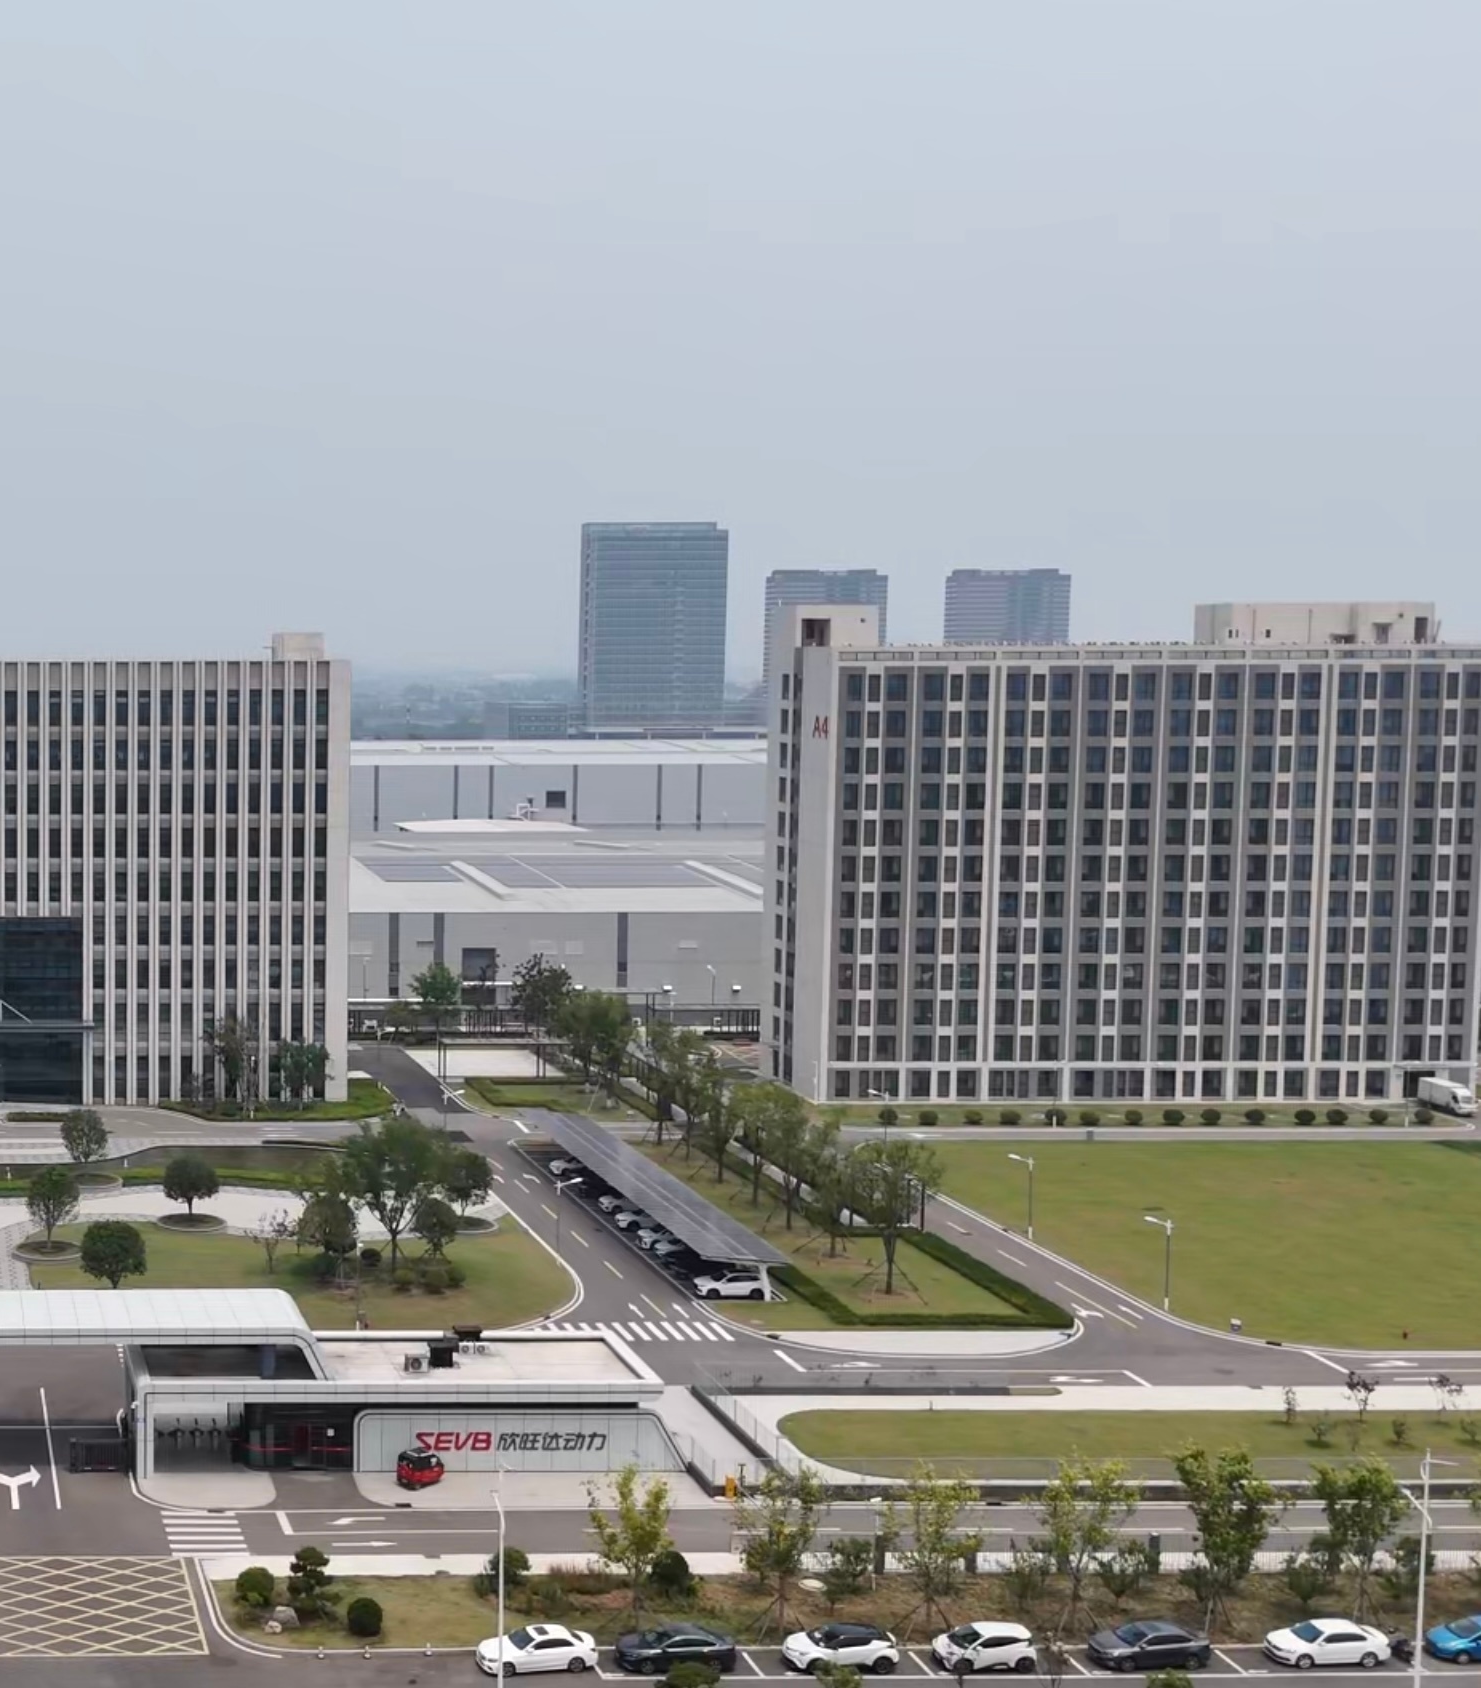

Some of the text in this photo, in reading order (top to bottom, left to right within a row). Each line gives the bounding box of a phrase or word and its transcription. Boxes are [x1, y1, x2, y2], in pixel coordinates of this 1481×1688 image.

[812, 715, 829, 739] A4
[416, 1432, 606, 1451] SEVB 欣旺达动力
